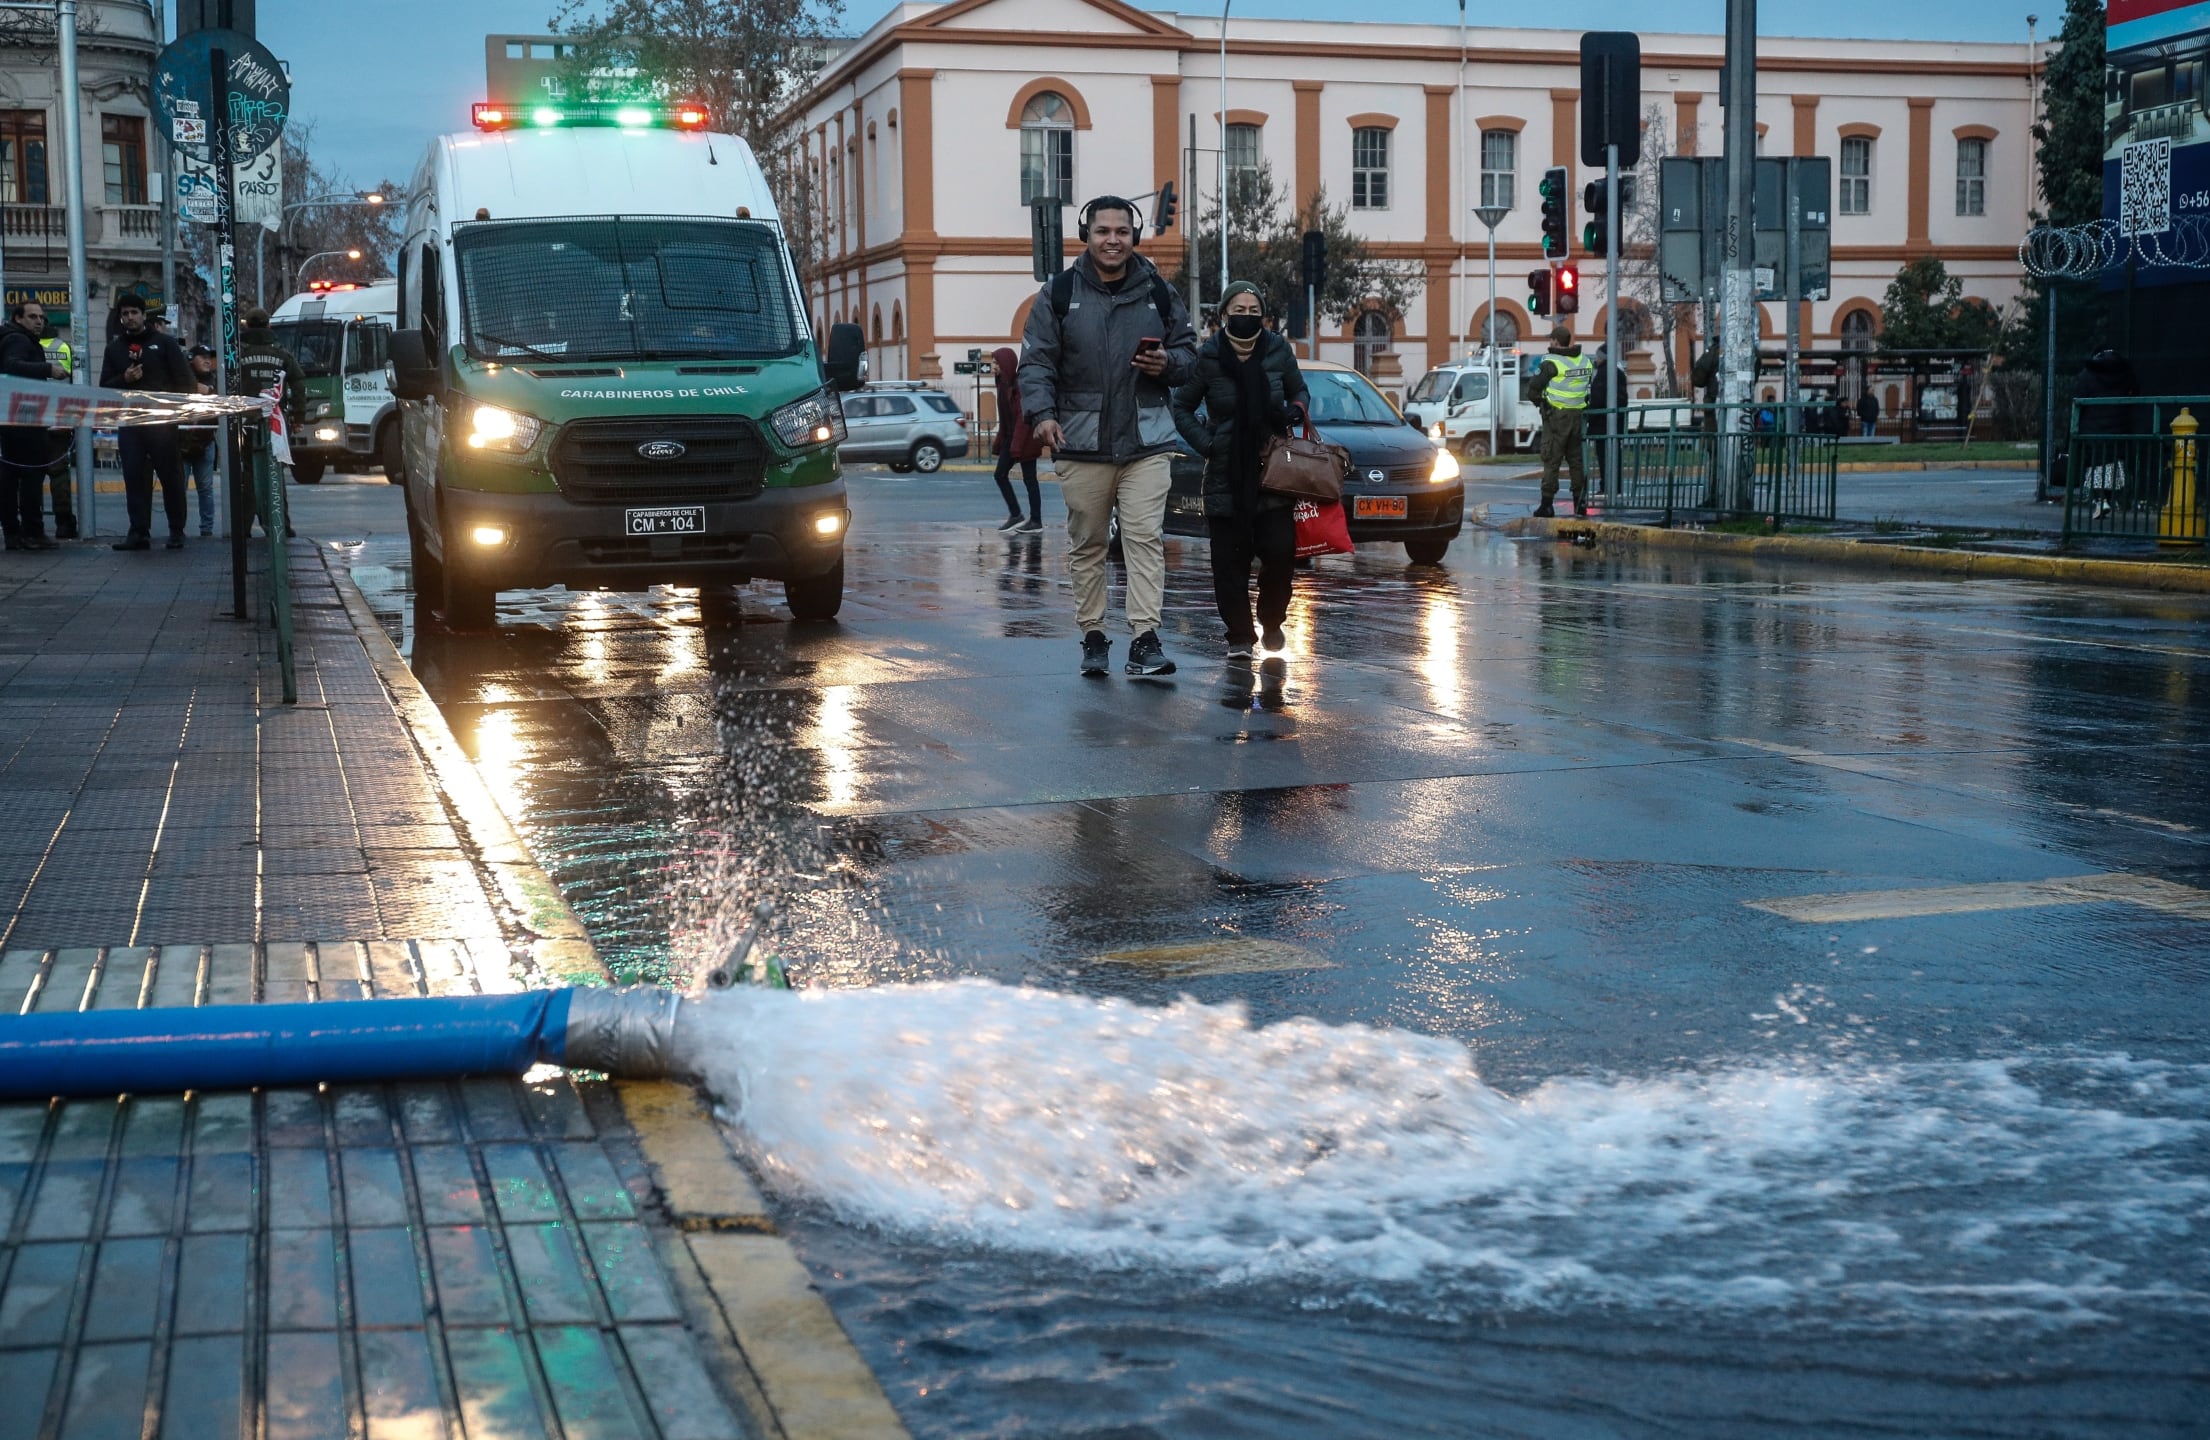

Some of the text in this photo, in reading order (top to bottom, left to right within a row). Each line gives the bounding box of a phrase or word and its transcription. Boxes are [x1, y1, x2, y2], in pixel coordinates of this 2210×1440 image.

[560, 385, 749, 399] CARABINEROS DE CHILE
[1358, 500, 1371, 511] CX
[632, 510, 672, 518] CARABINEROS
[632, 517, 695, 532] CM 104
